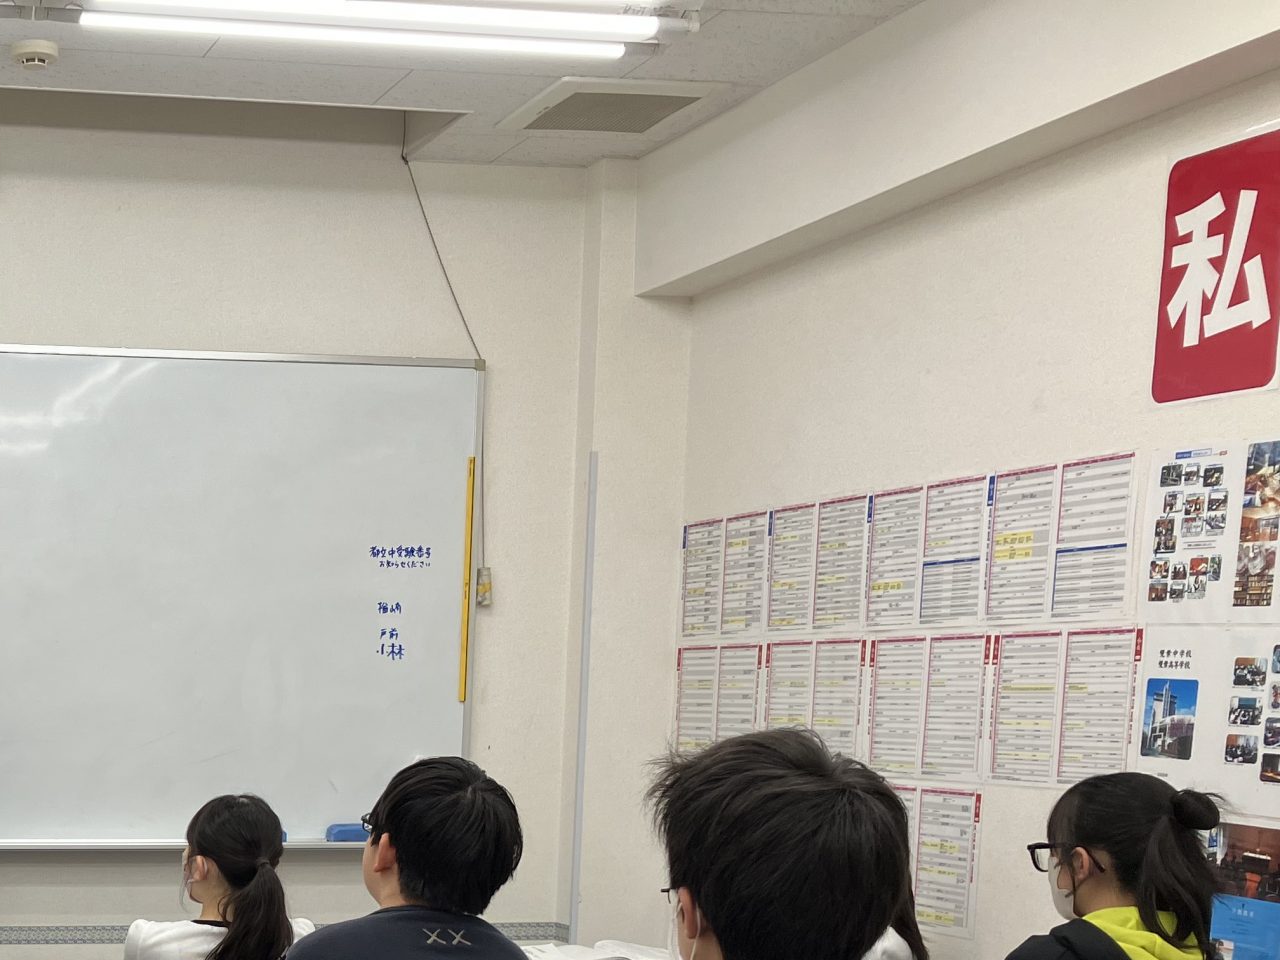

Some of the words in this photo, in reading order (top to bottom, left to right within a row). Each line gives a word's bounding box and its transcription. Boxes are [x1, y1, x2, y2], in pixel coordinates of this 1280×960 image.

[1166, 189, 1271, 348] 私
[369, 545, 431, 559] 都立中受験番号
[379, 560, 431, 569] お知らせください
[376, 643, 405, 660] 小林
